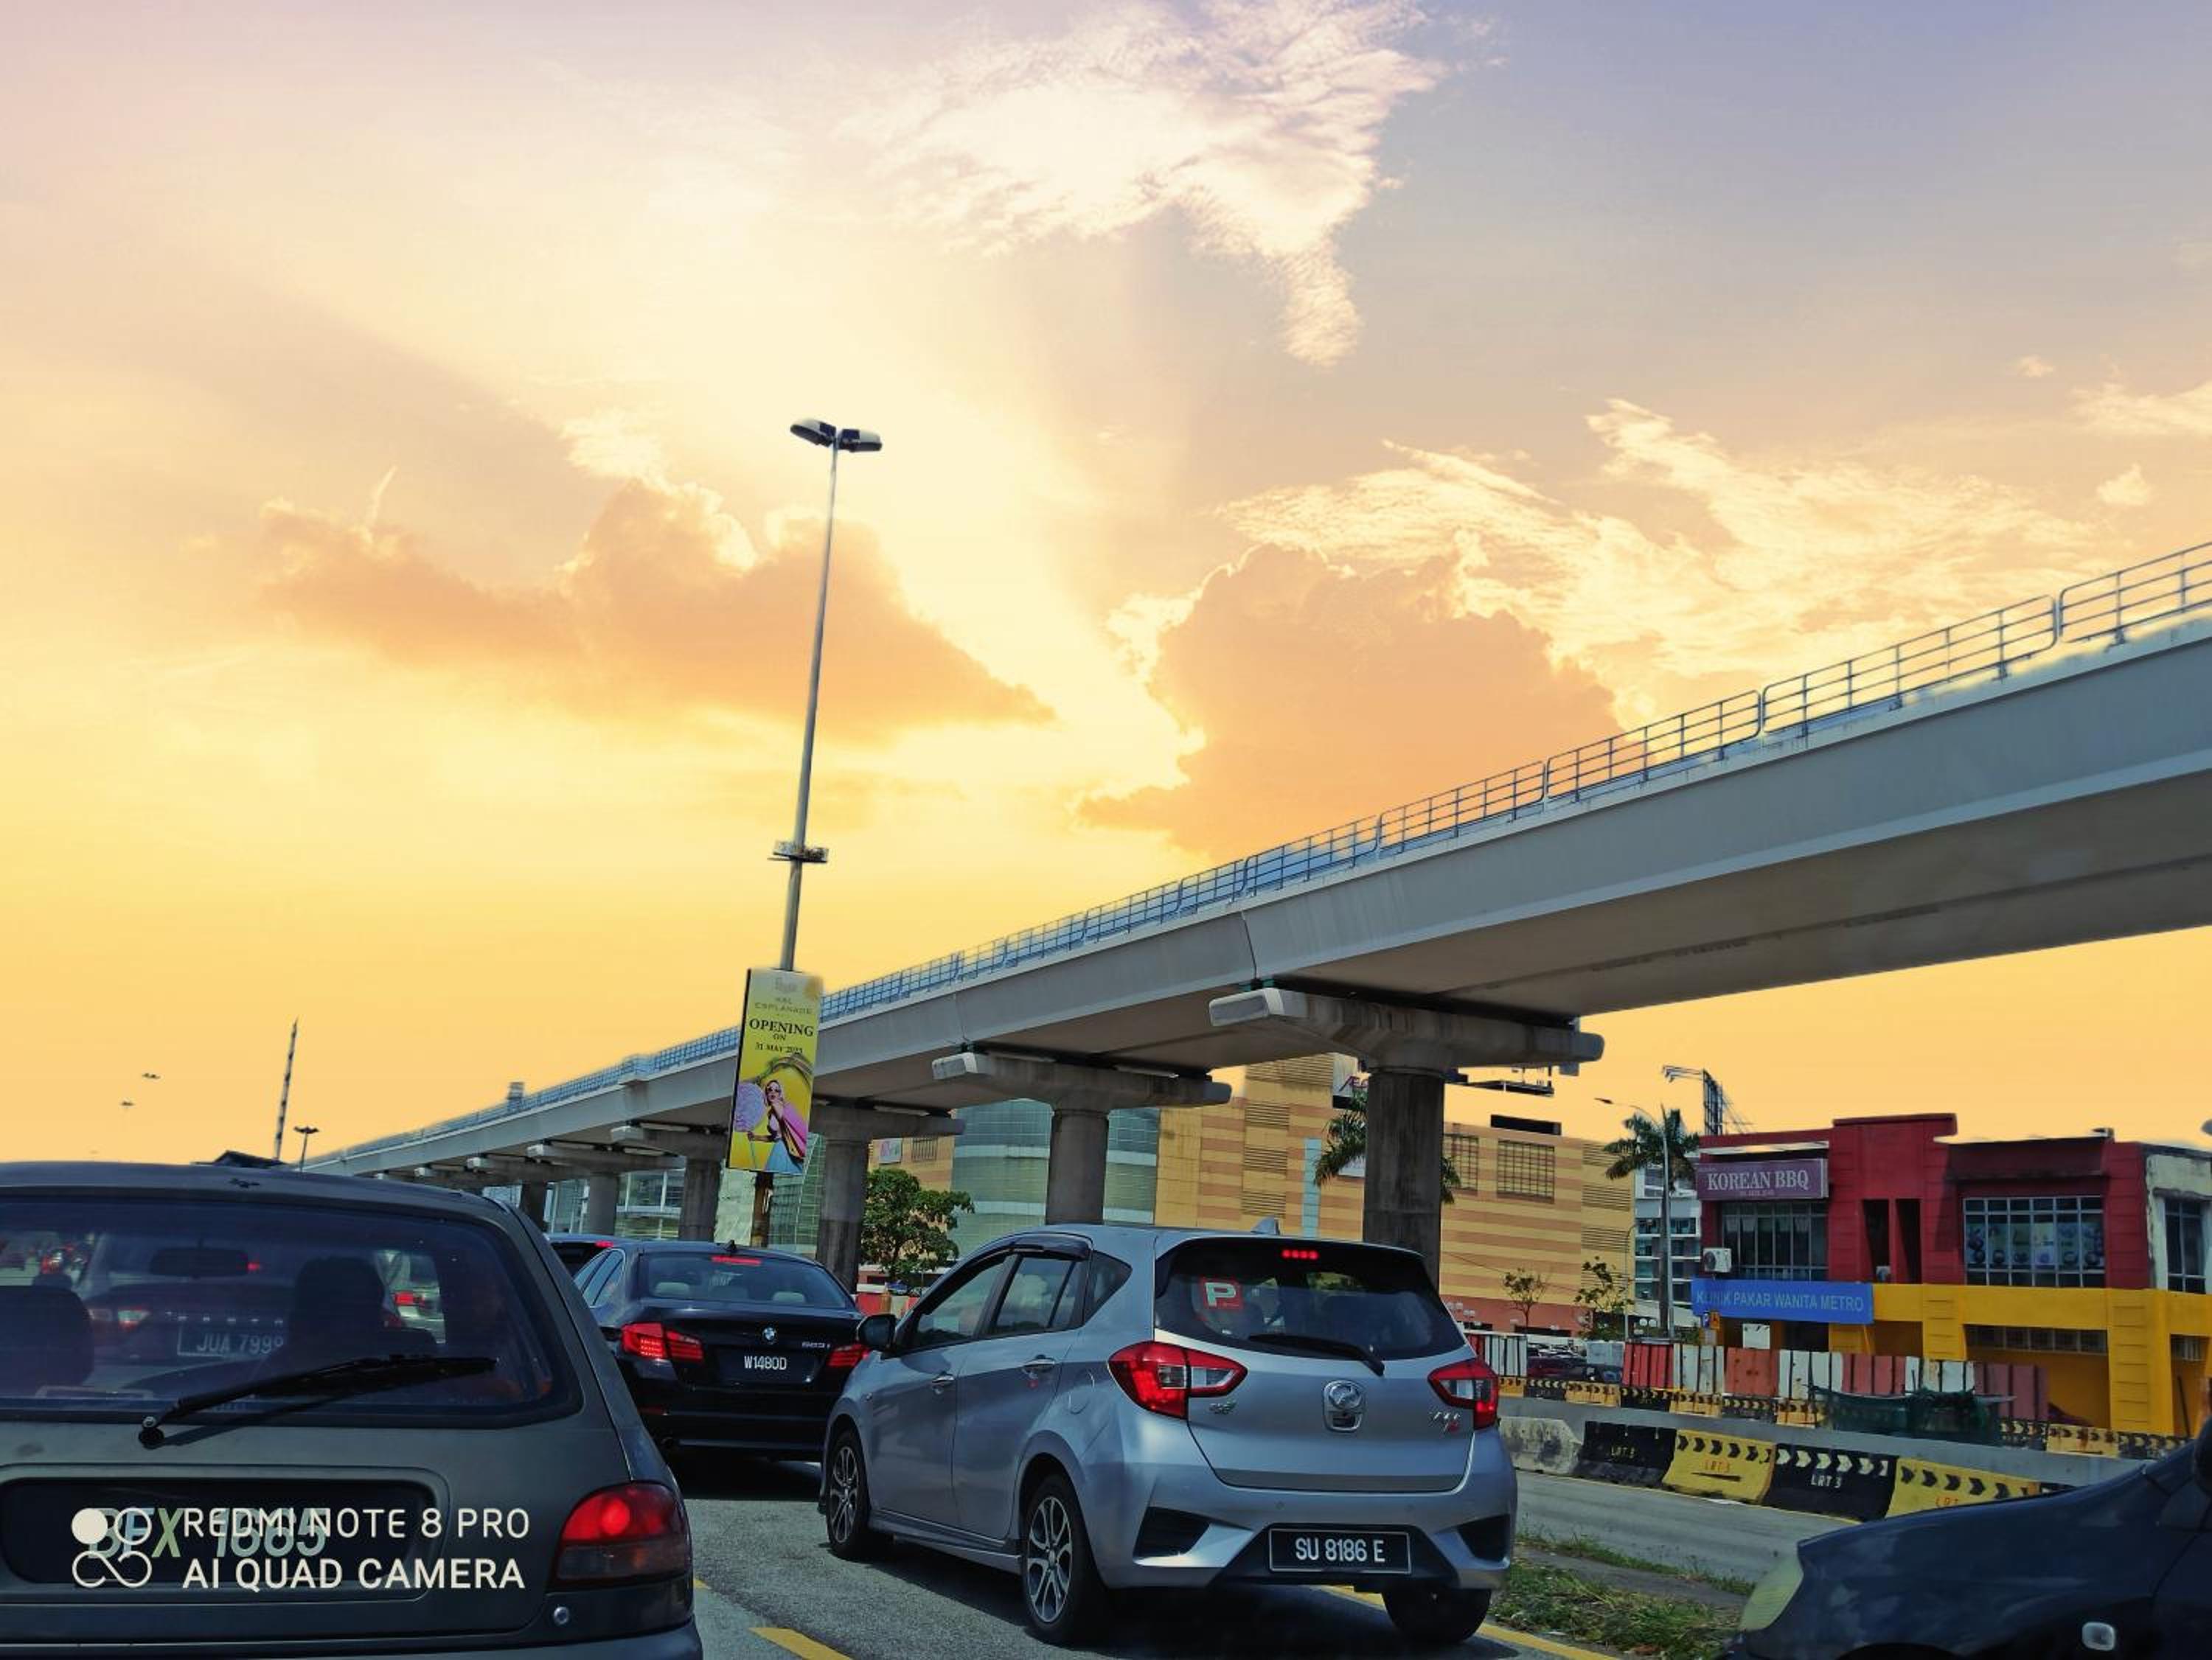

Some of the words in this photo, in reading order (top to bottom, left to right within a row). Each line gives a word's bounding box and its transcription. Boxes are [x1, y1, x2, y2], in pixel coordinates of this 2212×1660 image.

[749, 1018, 814, 1037] OPENING
[772, 1033, 786, 1041] ON
[766, 1043, 784, 1053] MAY
[1707, 1171, 1770, 1190] KOREAN
[1774, 1169, 1809, 1190] BBQ
[1204, 1282, 1237, 1307] P
[1697, 1291, 1731, 1305] KLINIK
[1733, 1291, 1770, 1308] PAKAR
[1773, 1292, 1818, 1310] WANITA
[1820, 1295, 1864, 1312] METRO
[196, 1333, 231, 1352] JUA
[1810, 1474, 1833, 1487] LRT
[1834, 1476, 1842, 1488] 3
[1295, 1537, 1320, 1560] SU
[1324, 1538, 1368, 1562] 8186
[1373, 1539, 1386, 1563] E
